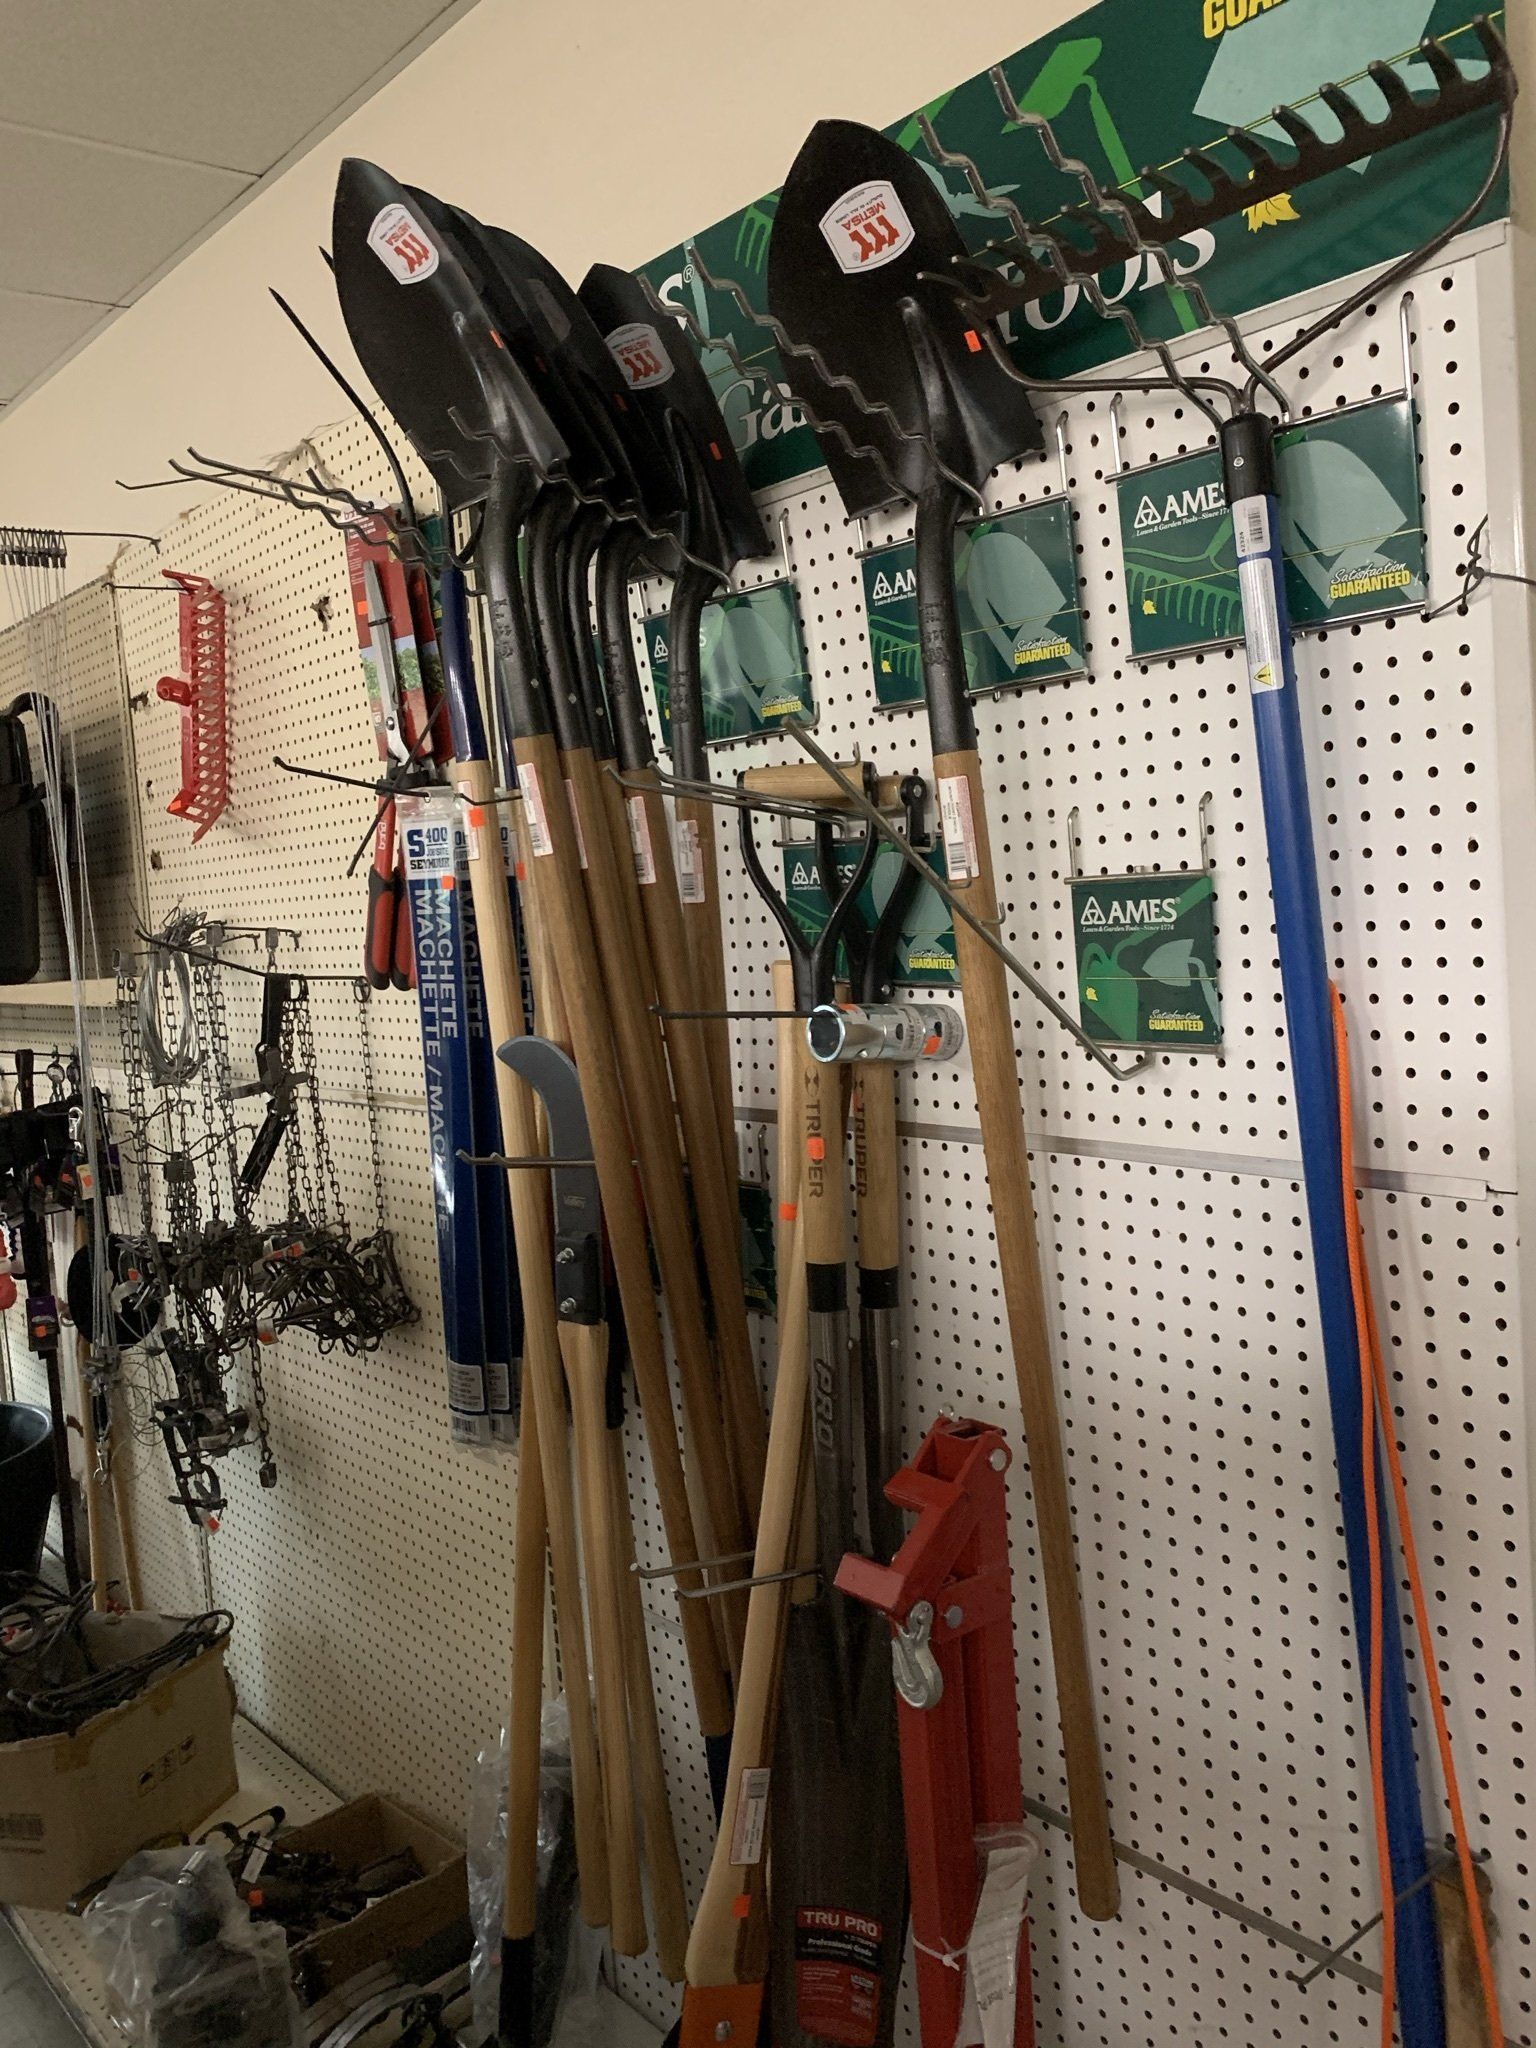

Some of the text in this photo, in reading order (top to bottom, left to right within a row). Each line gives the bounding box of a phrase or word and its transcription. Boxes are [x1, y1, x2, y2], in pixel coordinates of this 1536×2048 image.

[841, 201, 886, 231] METISA
[893, 568, 917, 595] AM
[1330, 560, 1407, 585] Satisfaction
[1330, 570, 1411, 599] GUARANTEED
[1014, 635, 1068, 653] Satisfaction
[1014, 642, 1071, 665] GUARANTEED
[407, 826, 448, 857] S 400
[435, 887, 459, 1040] MACHETE
[909, 958, 955, 970] GUARANTEED
[1148, 1019, 1204, 1032] GUARANTEED
[1149, 1008, 1201, 1020] Satisfaction
[414, 889, 441, 1058] MACHETTE
[429, 1085, 450, 1233] MACTE
[806, 1099, 824, 1198] TRER
[803, 1911, 878, 1938] TRU PRO
